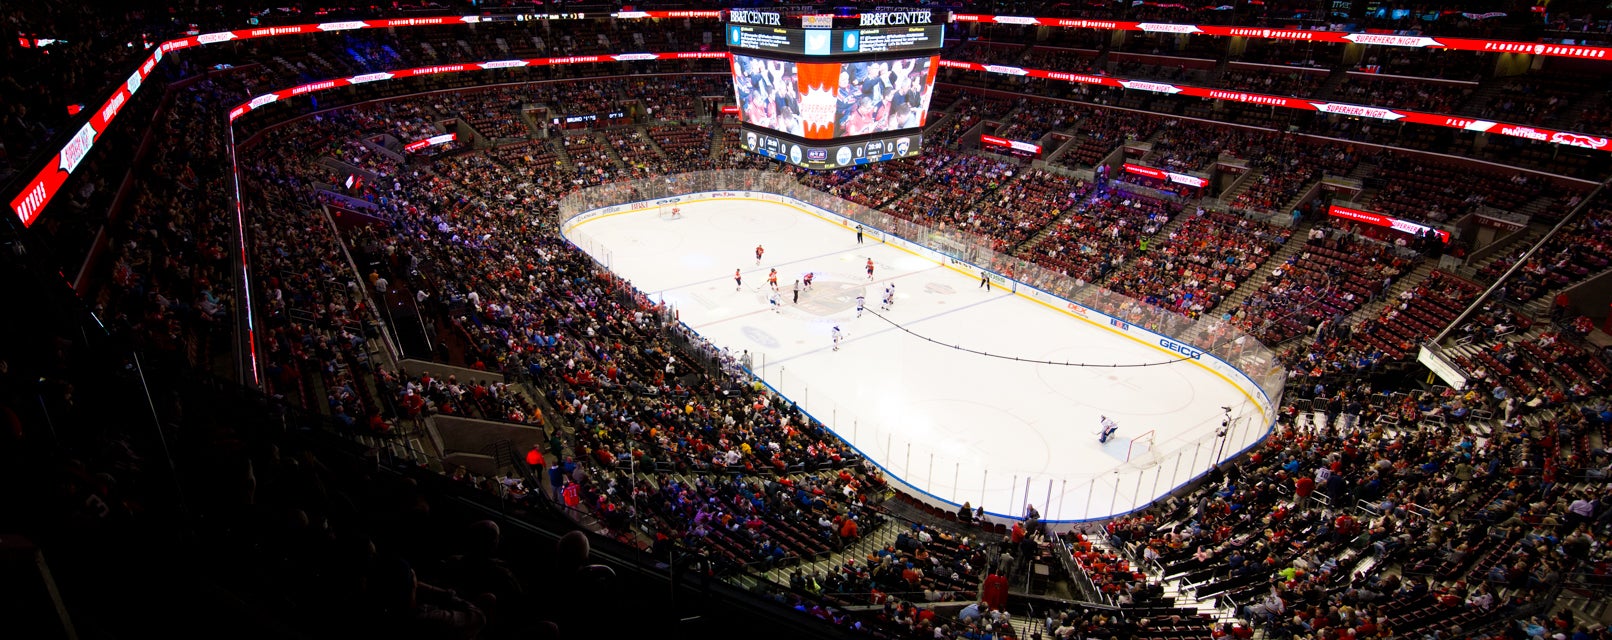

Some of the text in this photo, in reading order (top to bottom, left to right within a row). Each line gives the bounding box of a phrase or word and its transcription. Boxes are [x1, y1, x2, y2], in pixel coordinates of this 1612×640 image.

[730, 10, 781, 26] BB&T CENTER
[859, 11, 932, 26] BB&T CENTER
[1230, 28, 1313, 39] FLORIDA PANTHERS
[1355, 35, 1421, 46] SUPERHERO NIGHT
[1484, 42, 1606, 58] FLORIDA PANTHERS
[1048, 72, 1102, 84] FLORIDA PANTHERS
[1129, 81, 1171, 93] SUPERHERO NIGHT
[1209, 90, 1287, 106] FLORIDA PANTHERS
[1326, 104, 1388, 118] SUPERHERO NIGHT
[1501, 128, 1548, 141] PANTHERS
[856, 146, 863, 158] 0
[888, 142, 894, 152] 0
[17, 181, 47, 223] ANTHERS
[1159, 338, 1201, 361] GEICO
